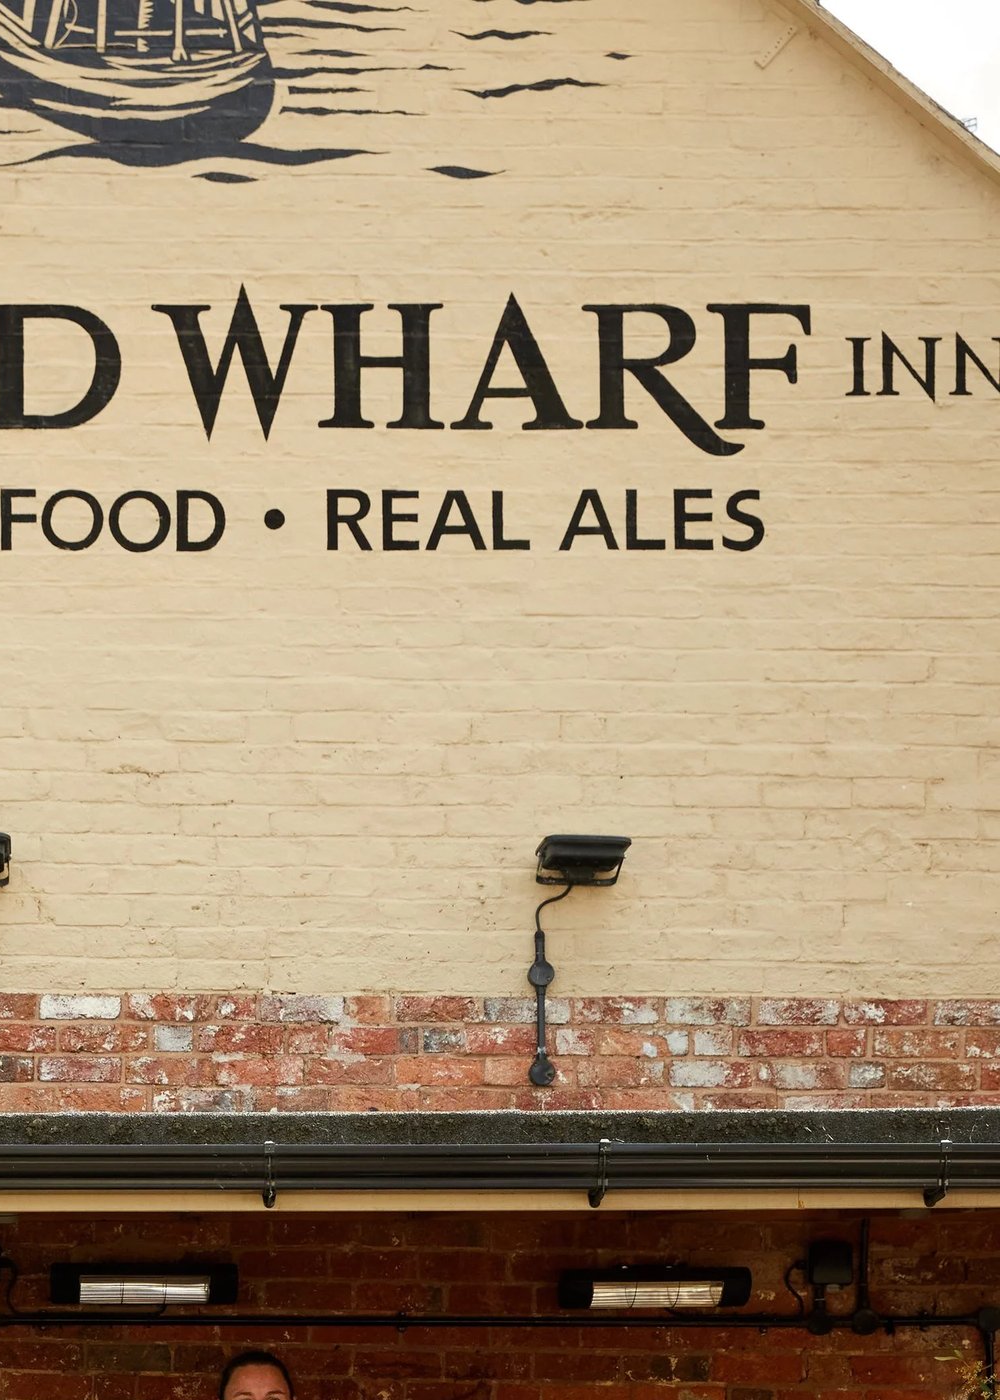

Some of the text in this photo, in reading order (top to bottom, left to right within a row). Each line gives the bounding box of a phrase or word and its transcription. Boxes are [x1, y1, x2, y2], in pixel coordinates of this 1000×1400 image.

[150, 284, 811, 456] WHARF
[845, 330, 1000, 403] INN
[0, 488, 226, 552] FOOD
[326, 489, 531, 552] REAL
[558, 488, 765, 552] ALES
